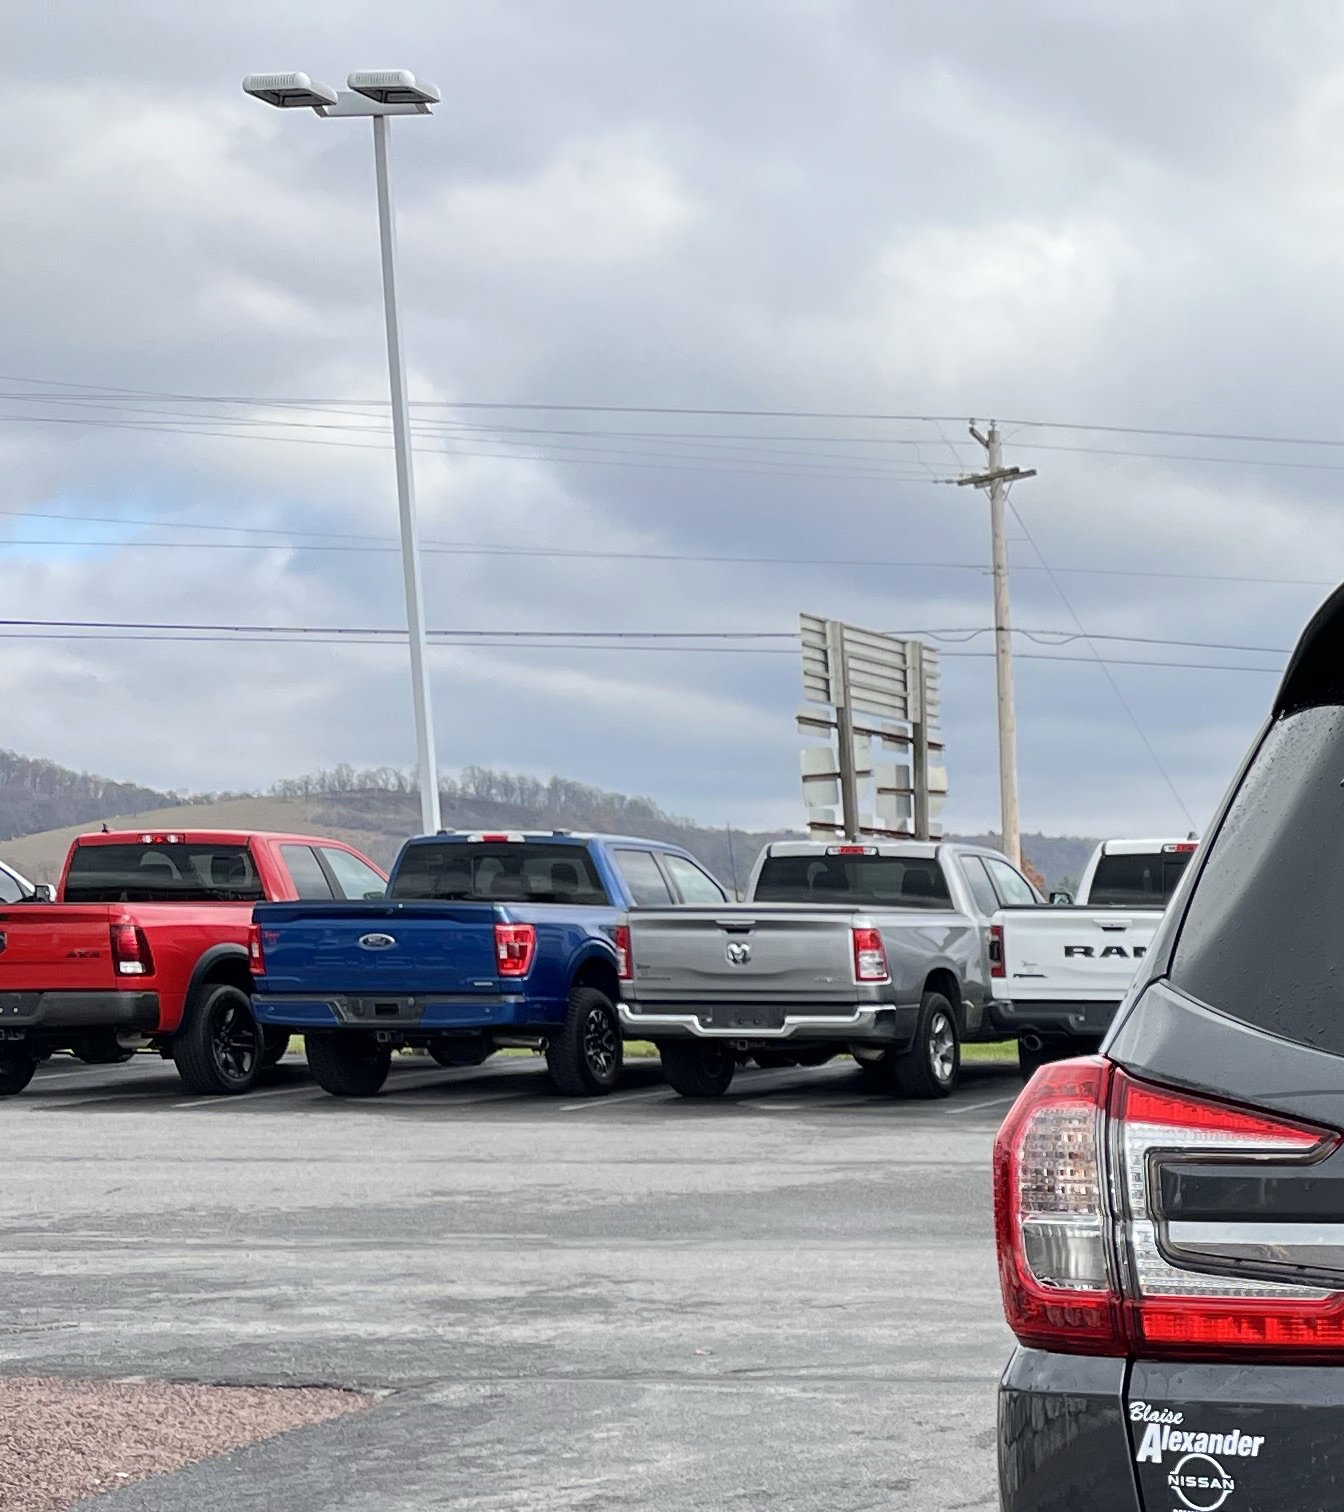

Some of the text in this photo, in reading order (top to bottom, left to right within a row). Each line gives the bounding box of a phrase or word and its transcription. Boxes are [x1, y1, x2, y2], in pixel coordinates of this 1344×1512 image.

[1129, 1401, 1184, 1424] Blaise
[1136, 1423, 1265, 1463] Alexander
[1168, 1475, 1235, 1490] NISSAN
